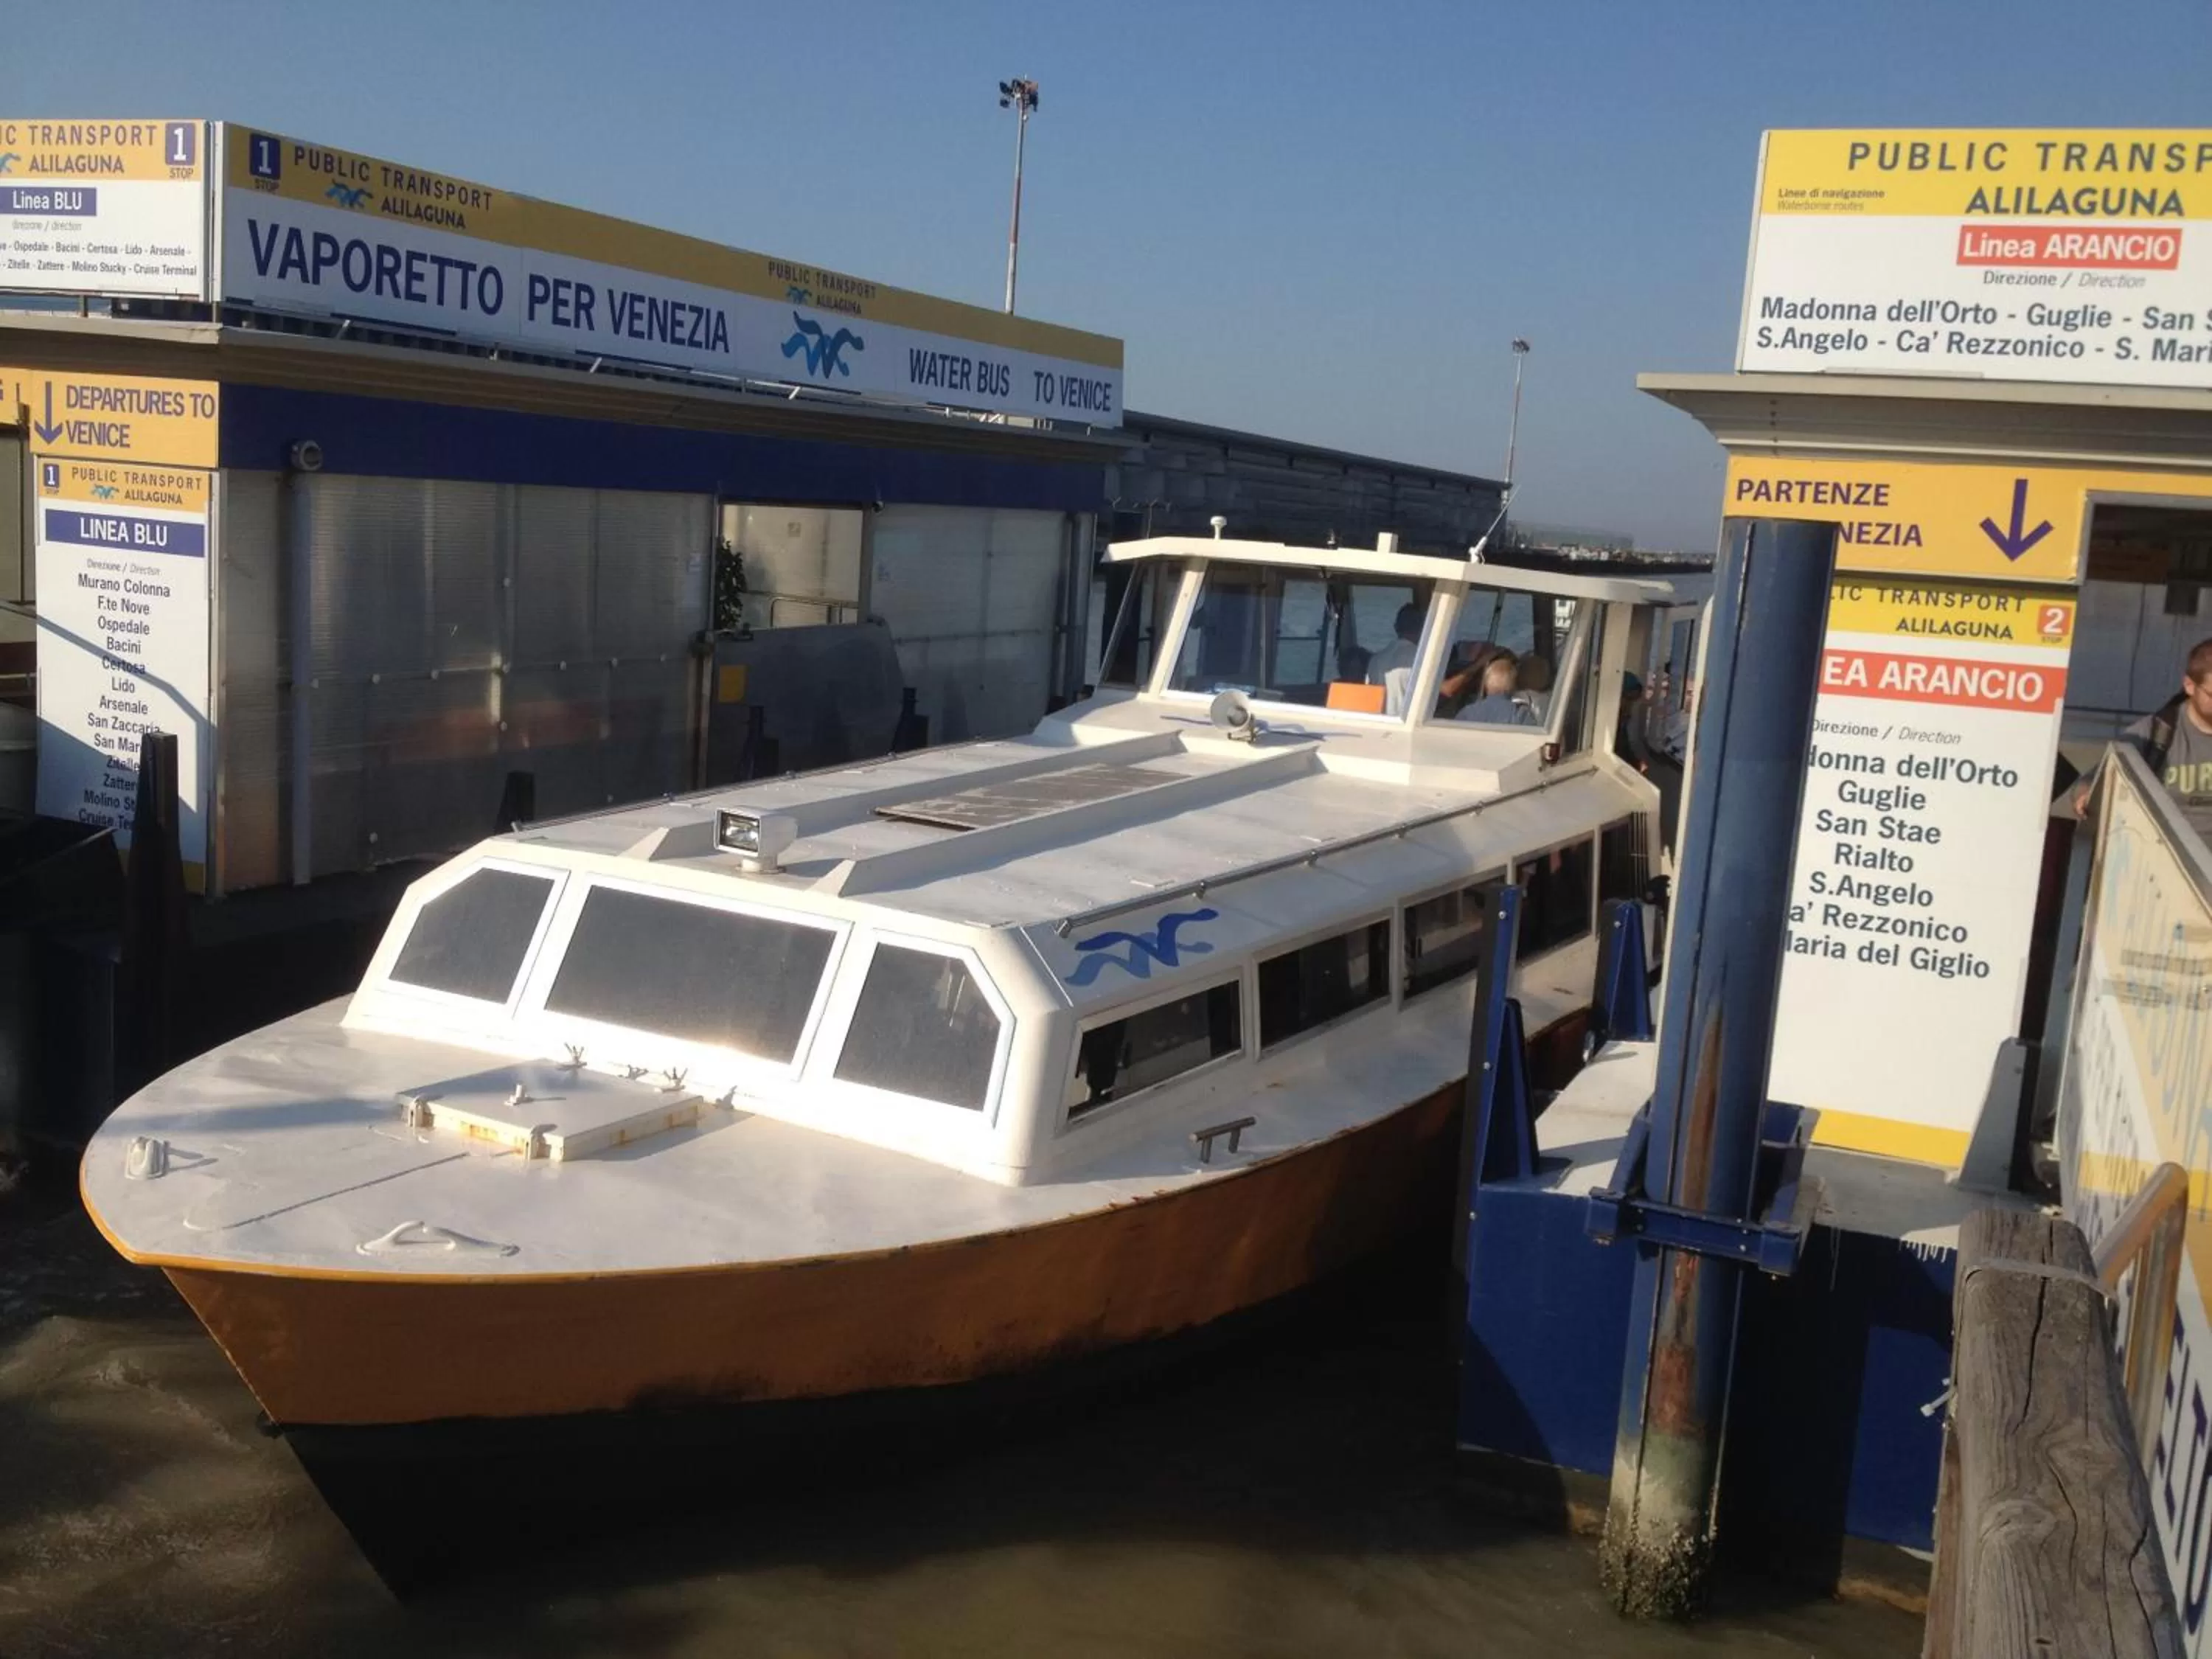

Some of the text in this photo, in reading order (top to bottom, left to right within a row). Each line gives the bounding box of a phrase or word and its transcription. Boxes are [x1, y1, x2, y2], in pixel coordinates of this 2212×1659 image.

[28, 124, 158, 146] TRANSPORT
[173, 127, 187, 161] 1
[28, 153, 125, 174] ALILAGUNA
[258, 140, 272, 175] 1
[1847, 142, 2008, 173] PUBLIC
[169, 167, 193, 178] STOP
[294, 145, 493, 212] PUBLIC TRANSPORT
[13, 190, 83, 210] Linea BLU
[1822, 188, 1885, 200] navigazione
[1964, 185, 2185, 218] ALILAGUNA
[380, 196, 466, 230] ALILAGUNA
[55, 241, 80, 253] Bacini
[125, 243, 143, 254] Lido
[150, 244, 185, 256] Arsenale
[1963, 232, 2175, 262] Linea ARANCIO
[72, 260, 98, 271] Molino
[162, 264, 197, 276] Terminal
[768, 260, 877, 299] PUBLIC TRANSPORT
[1982, 270, 2058, 287] Direzione
[2078, 272, 2146, 288] Direction
[247, 218, 730, 353] VAPORETTO PER VENEZIA
[1760, 296, 1878, 321] Madonna
[1886, 299, 1998, 325] dell'Orto
[2026, 302, 2112, 332] Guglie
[2141, 306, 2195, 331] San
[1756, 325, 1869, 355] S.Angelo
[1945, 330, 2085, 358] Rezzonico
[2113, 336, 2140, 361] S.
[909, 347, 1113, 413] WATER BUS TO VENICE
[66, 383, 216, 420] DEPARTURES TO
[65, 420, 131, 449] VENICE
[47, 465, 56, 486] 1
[72, 466, 203, 491] PUBLIC TRANSPORT
[124, 488, 184, 505] ALILAGUNA
[1736, 478, 1891, 507] PARTENZE
[80, 516, 169, 546] LINEA BLU
[1838, 521, 1924, 547] NEZIA
[77, 573, 171, 598] Murano Colonna
[97, 595, 150, 616] F.te Nove
[1876, 586, 2027, 613] TRANSPORT
[97, 616, 150, 636] Ospedale
[1895, 616, 2014, 640] ALILAGUNA
[2042, 607, 2065, 635] 2
[106, 636, 142, 655] Bacini
[2040, 636, 2062, 644] STOP
[101, 655, 146, 675] Certosa
[111, 677, 136, 694] Lido
[1877, 660, 2045, 703] ARANCIO
[99, 695, 149, 715] Arsenale
[87, 712, 161, 735] San Zaccaria
[1899, 726, 1962, 745] Direction
[94, 732, 142, 754] San Mar
[102, 774, 136, 791] Zatter
[1896, 754, 2019, 788] dell'Orto
[83, 790, 121, 809] Molino
[1837, 779, 1927, 812] Guglie
[78, 809, 114, 827] Cruise
[1815, 809, 1942, 844] San Stae
[1834, 842, 1914, 873] Rialto
[1809, 870, 1934, 908] S.Angelo
[1790, 901, 1969, 944] a' Rezzonico
[1857, 941, 1900, 967] del
[1909, 946, 1991, 979] Giglio
